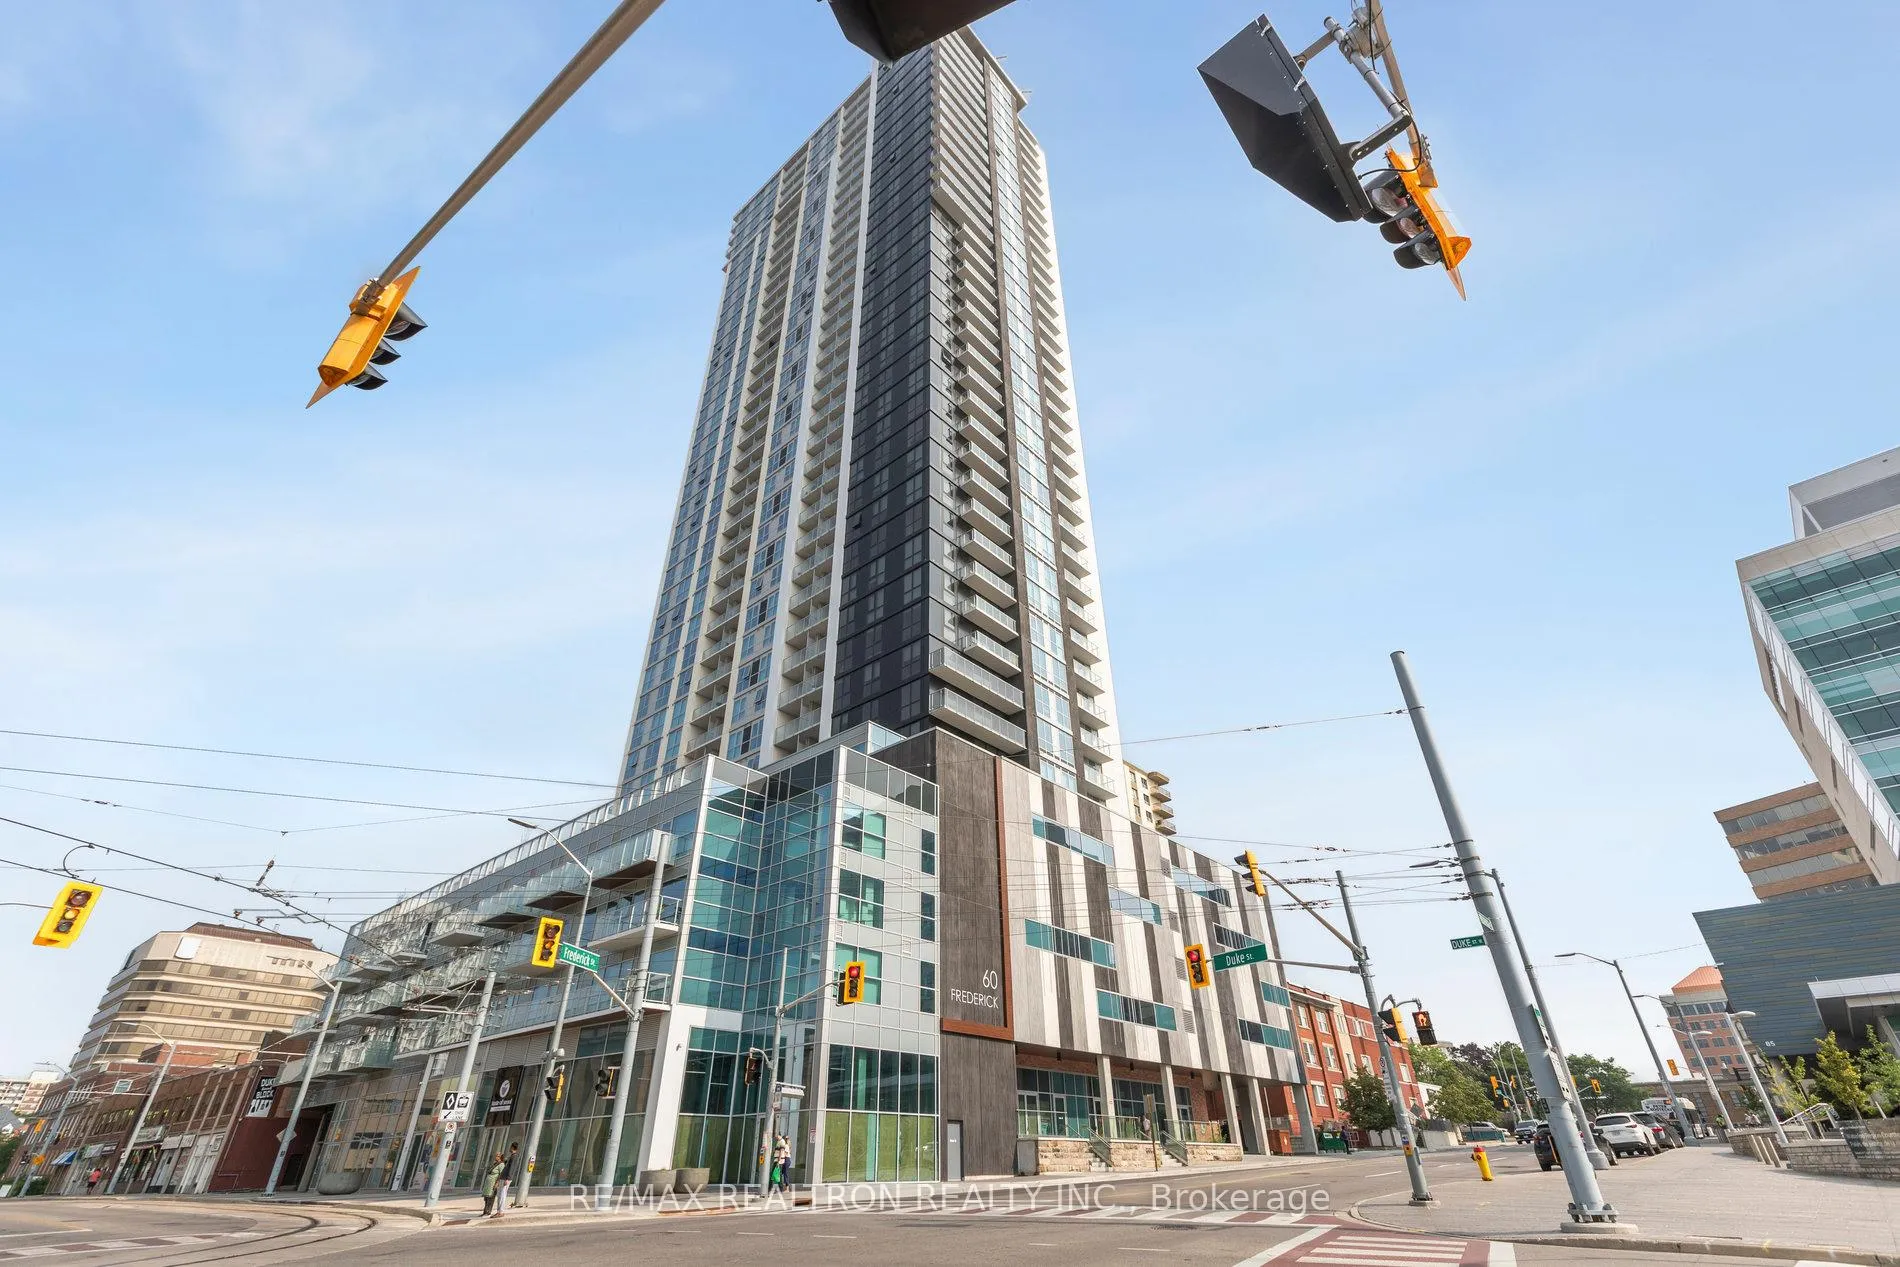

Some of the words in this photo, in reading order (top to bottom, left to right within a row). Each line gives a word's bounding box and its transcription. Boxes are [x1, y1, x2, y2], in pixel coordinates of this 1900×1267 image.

[1452, 939, 1472, 948] DUKE
[564, 946, 590, 967] Frederick
[1225, 953, 1245, 966] Duke
[982, 969, 998, 989] 60
[950, 988, 999, 1009] FREDERICK
